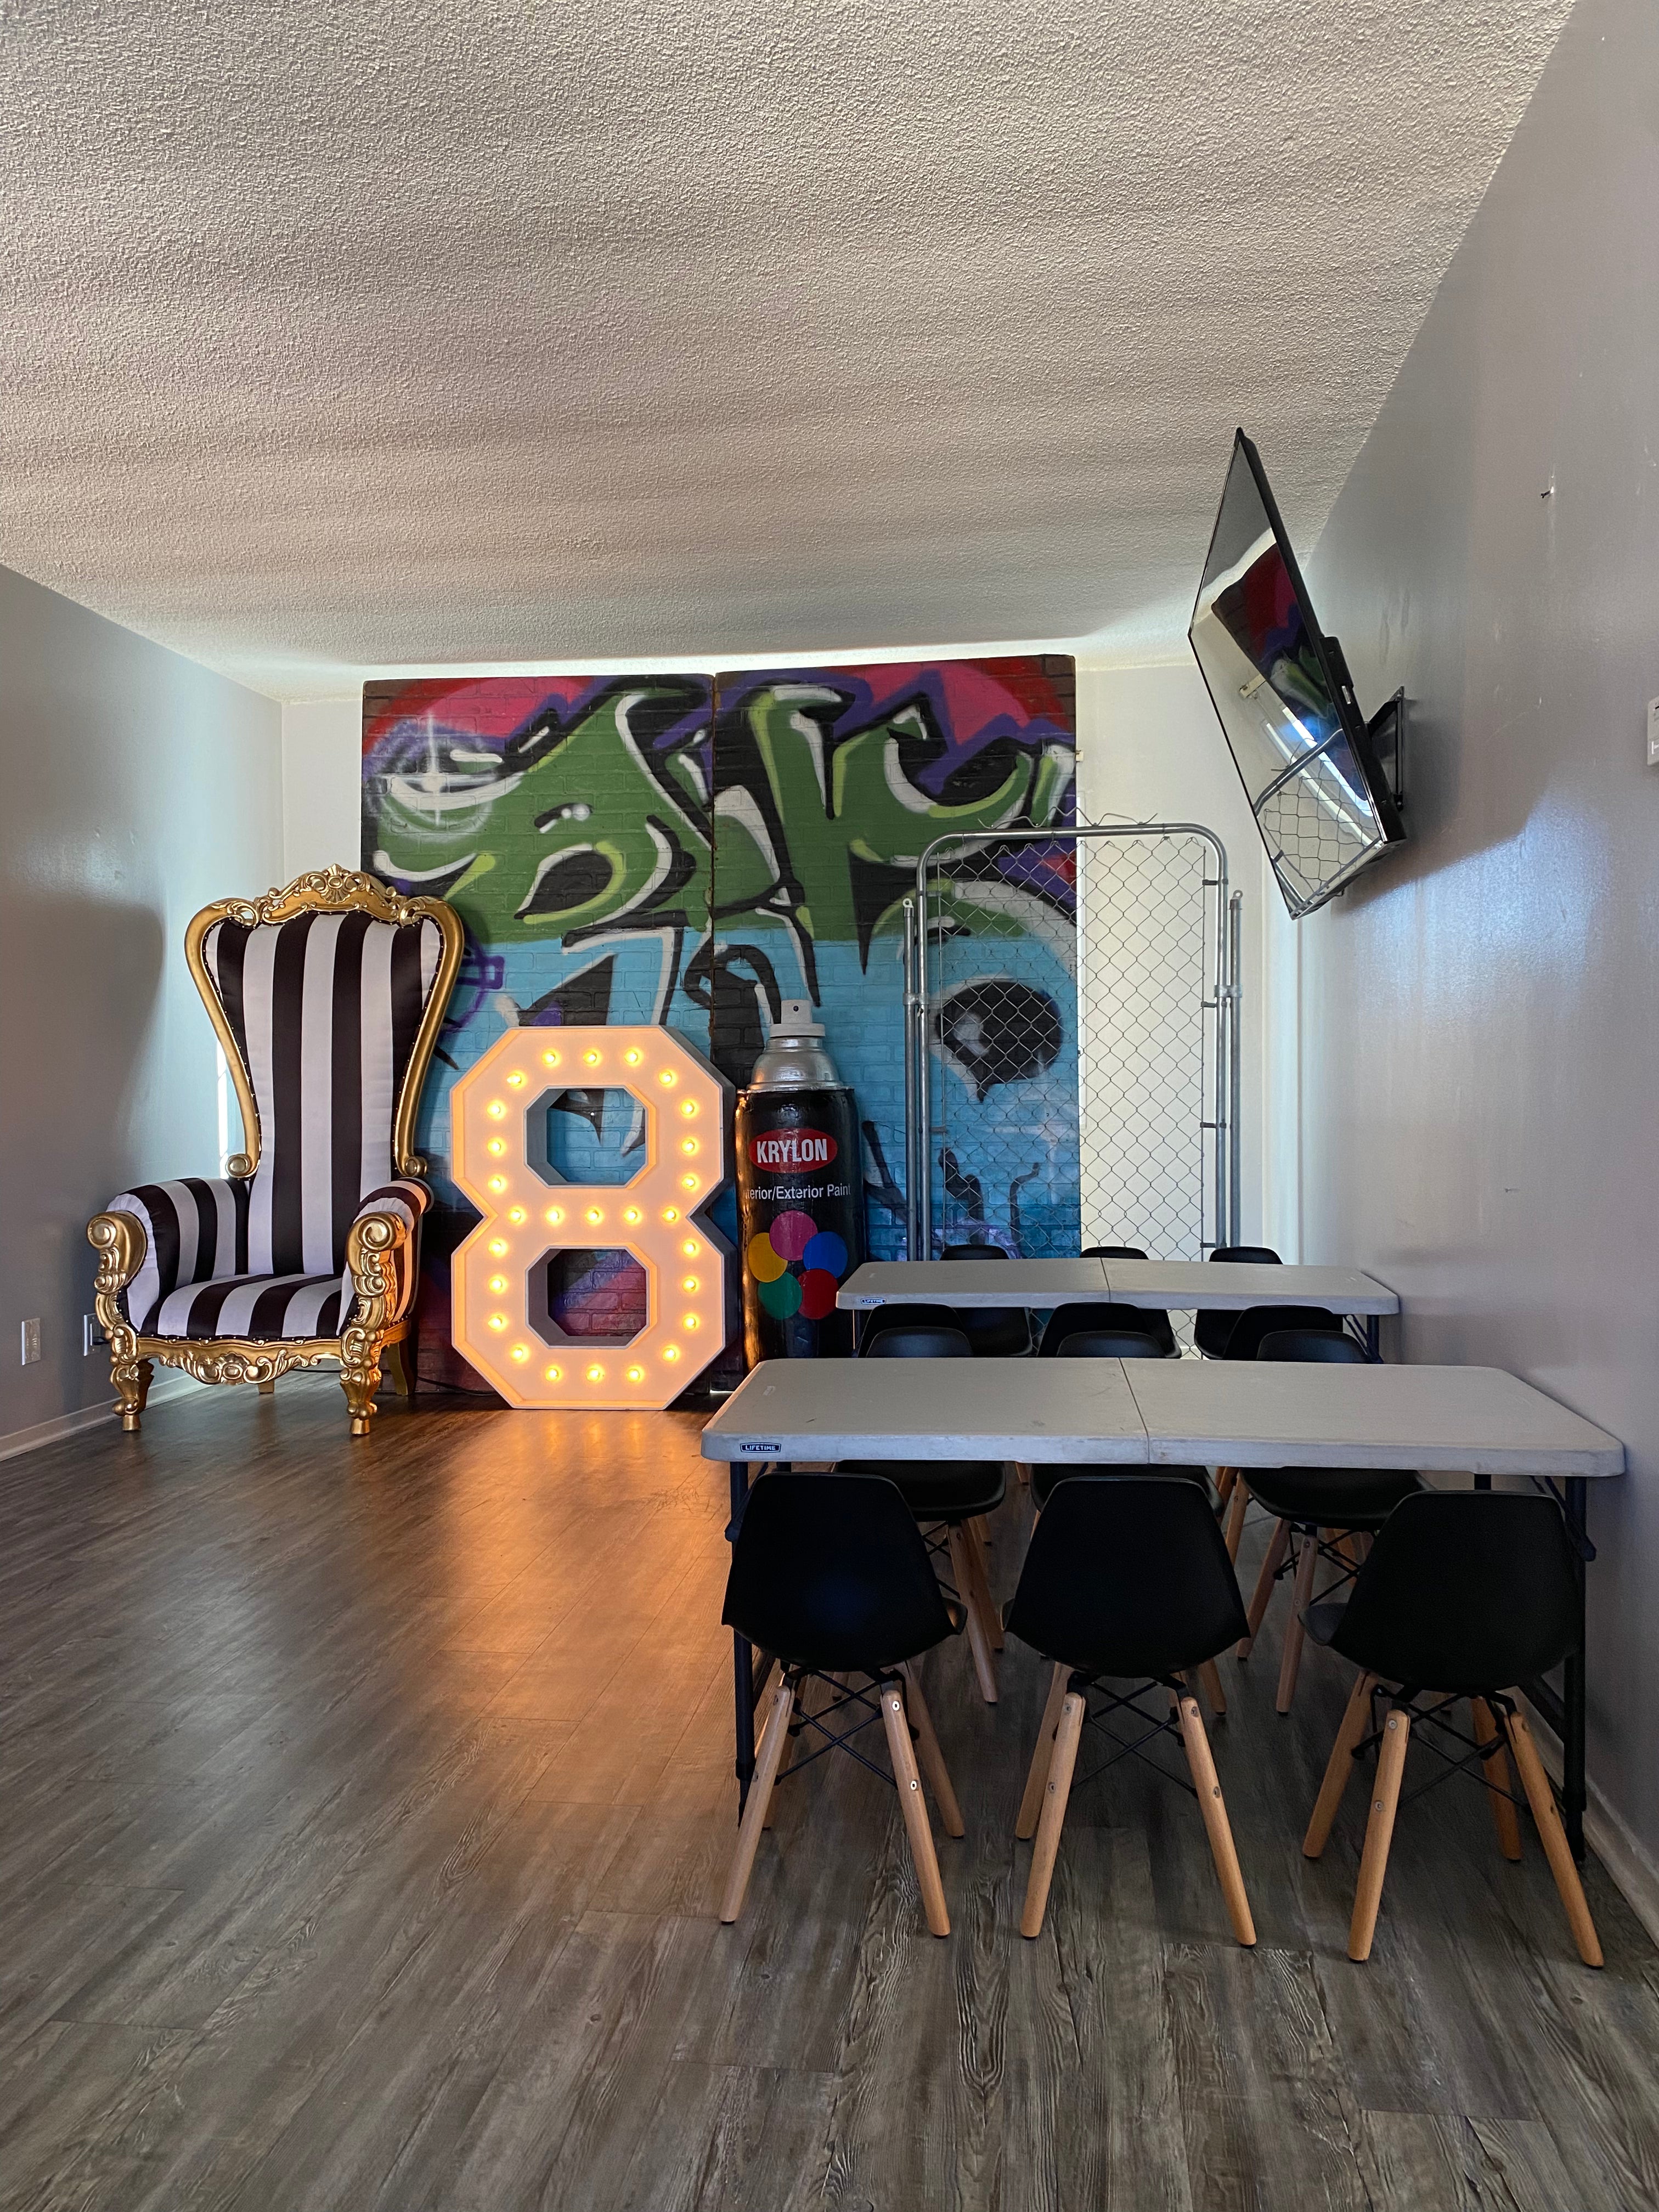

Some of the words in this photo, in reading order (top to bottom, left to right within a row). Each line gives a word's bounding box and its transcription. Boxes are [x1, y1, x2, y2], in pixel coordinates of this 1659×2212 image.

[757, 1138, 827, 1163] KRYLON
[827, 1183, 851, 1197] Paint
[450, 1025, 725, 1410] 8
